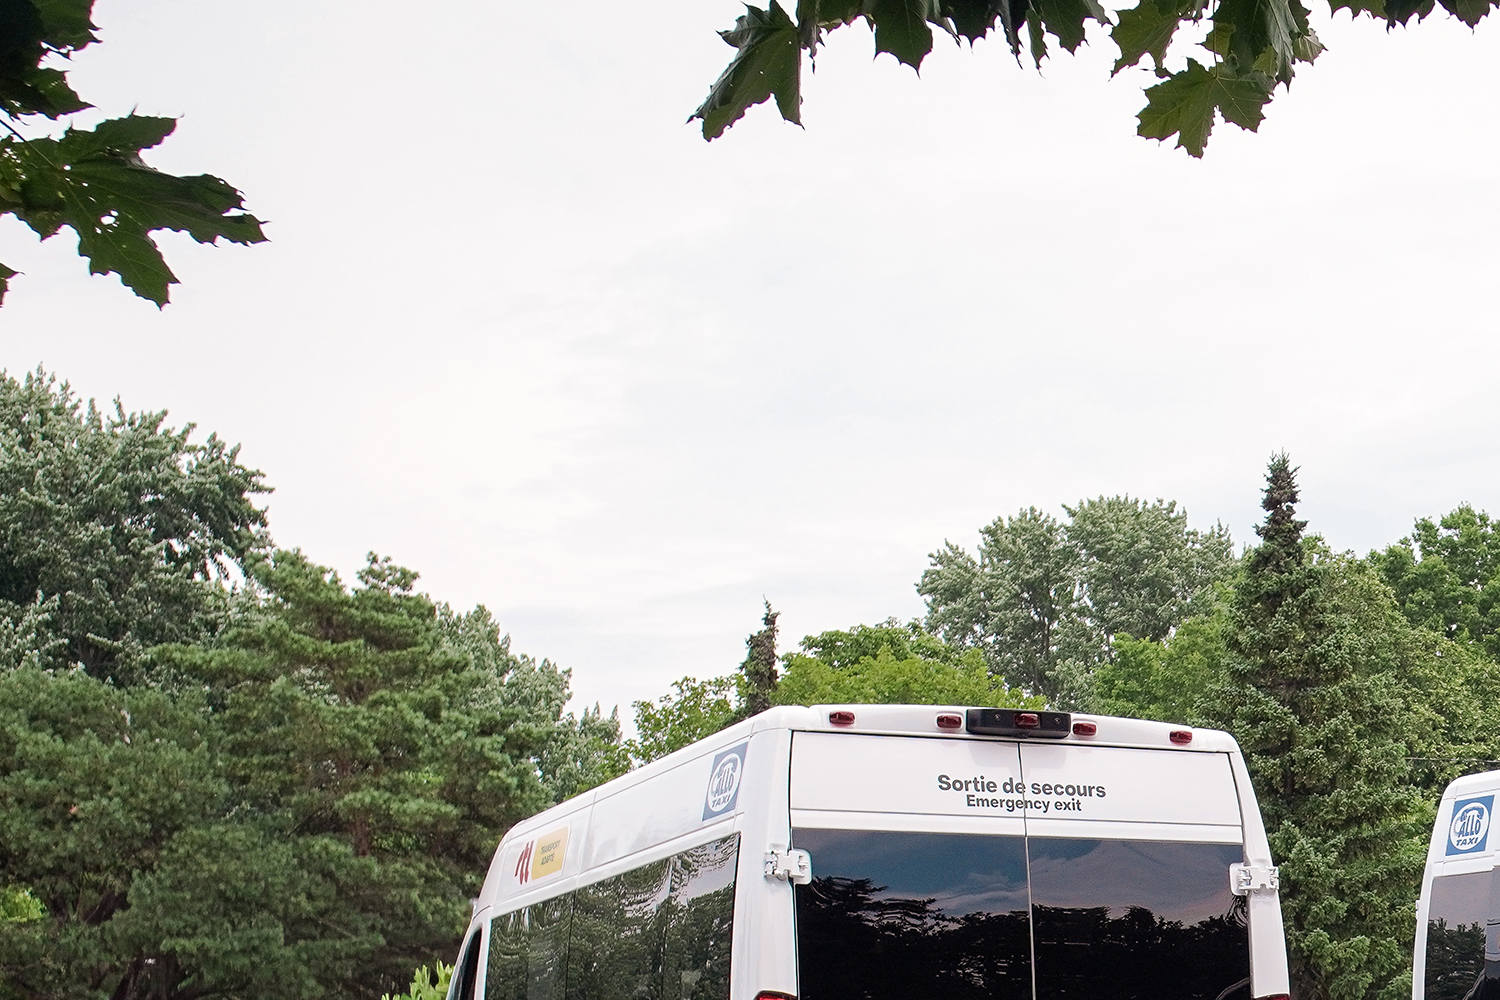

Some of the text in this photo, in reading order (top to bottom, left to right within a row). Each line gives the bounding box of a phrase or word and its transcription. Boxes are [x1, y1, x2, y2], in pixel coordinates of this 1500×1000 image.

[937, 774, 1107, 798] Sortie de secours
[711, 794, 731, 808] TAXI
[966, 794, 1082, 813] Emergency exit
[1457, 814, 1481, 838] ALLO
[1456, 837, 1478, 847] TAXI
[514, 839, 534, 885] rtl
